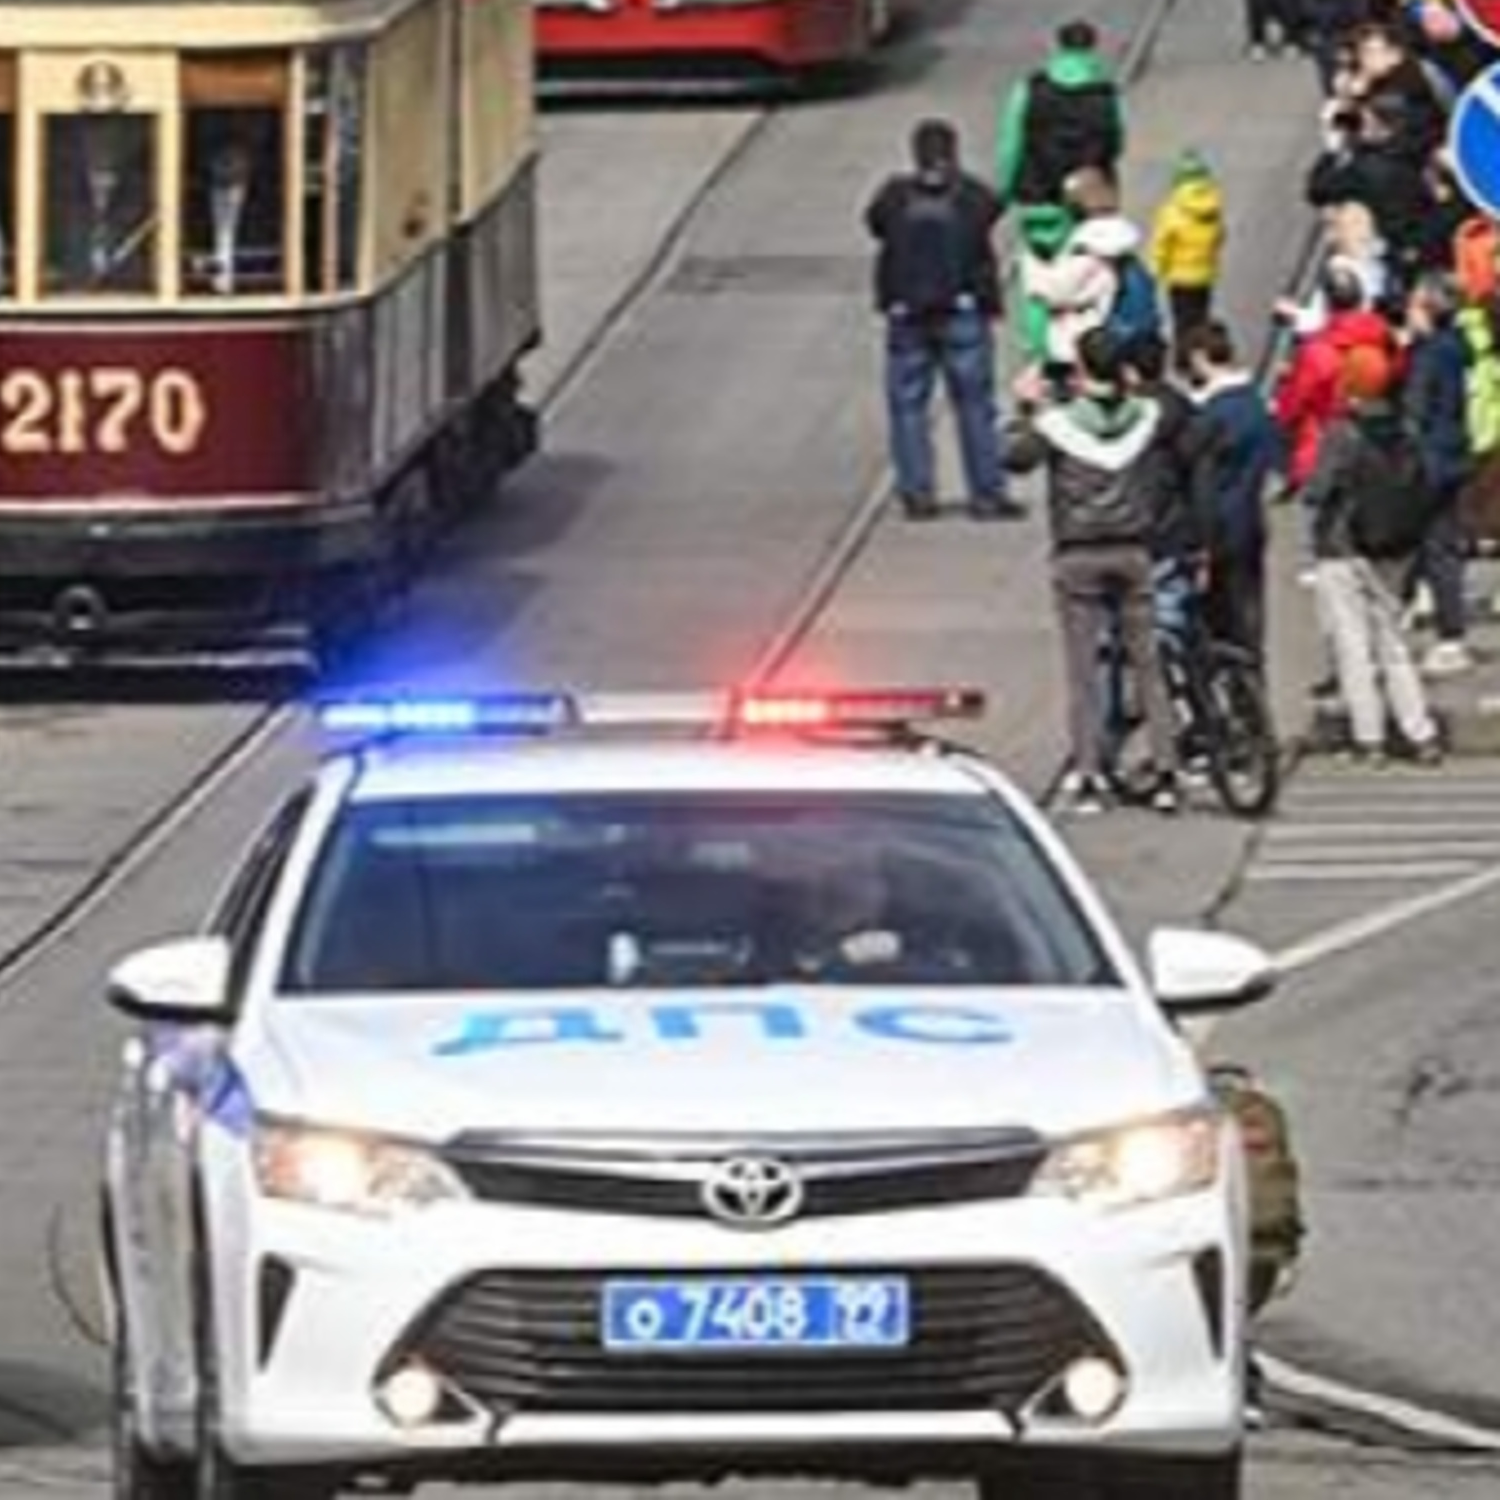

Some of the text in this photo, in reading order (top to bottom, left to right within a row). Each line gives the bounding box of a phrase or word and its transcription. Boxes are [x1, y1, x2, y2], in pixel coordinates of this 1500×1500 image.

[0, 367, 205, 453] 2170
[430, 1004, 1016, 1057] ДПС
[678, 1284, 807, 1341] 7408
